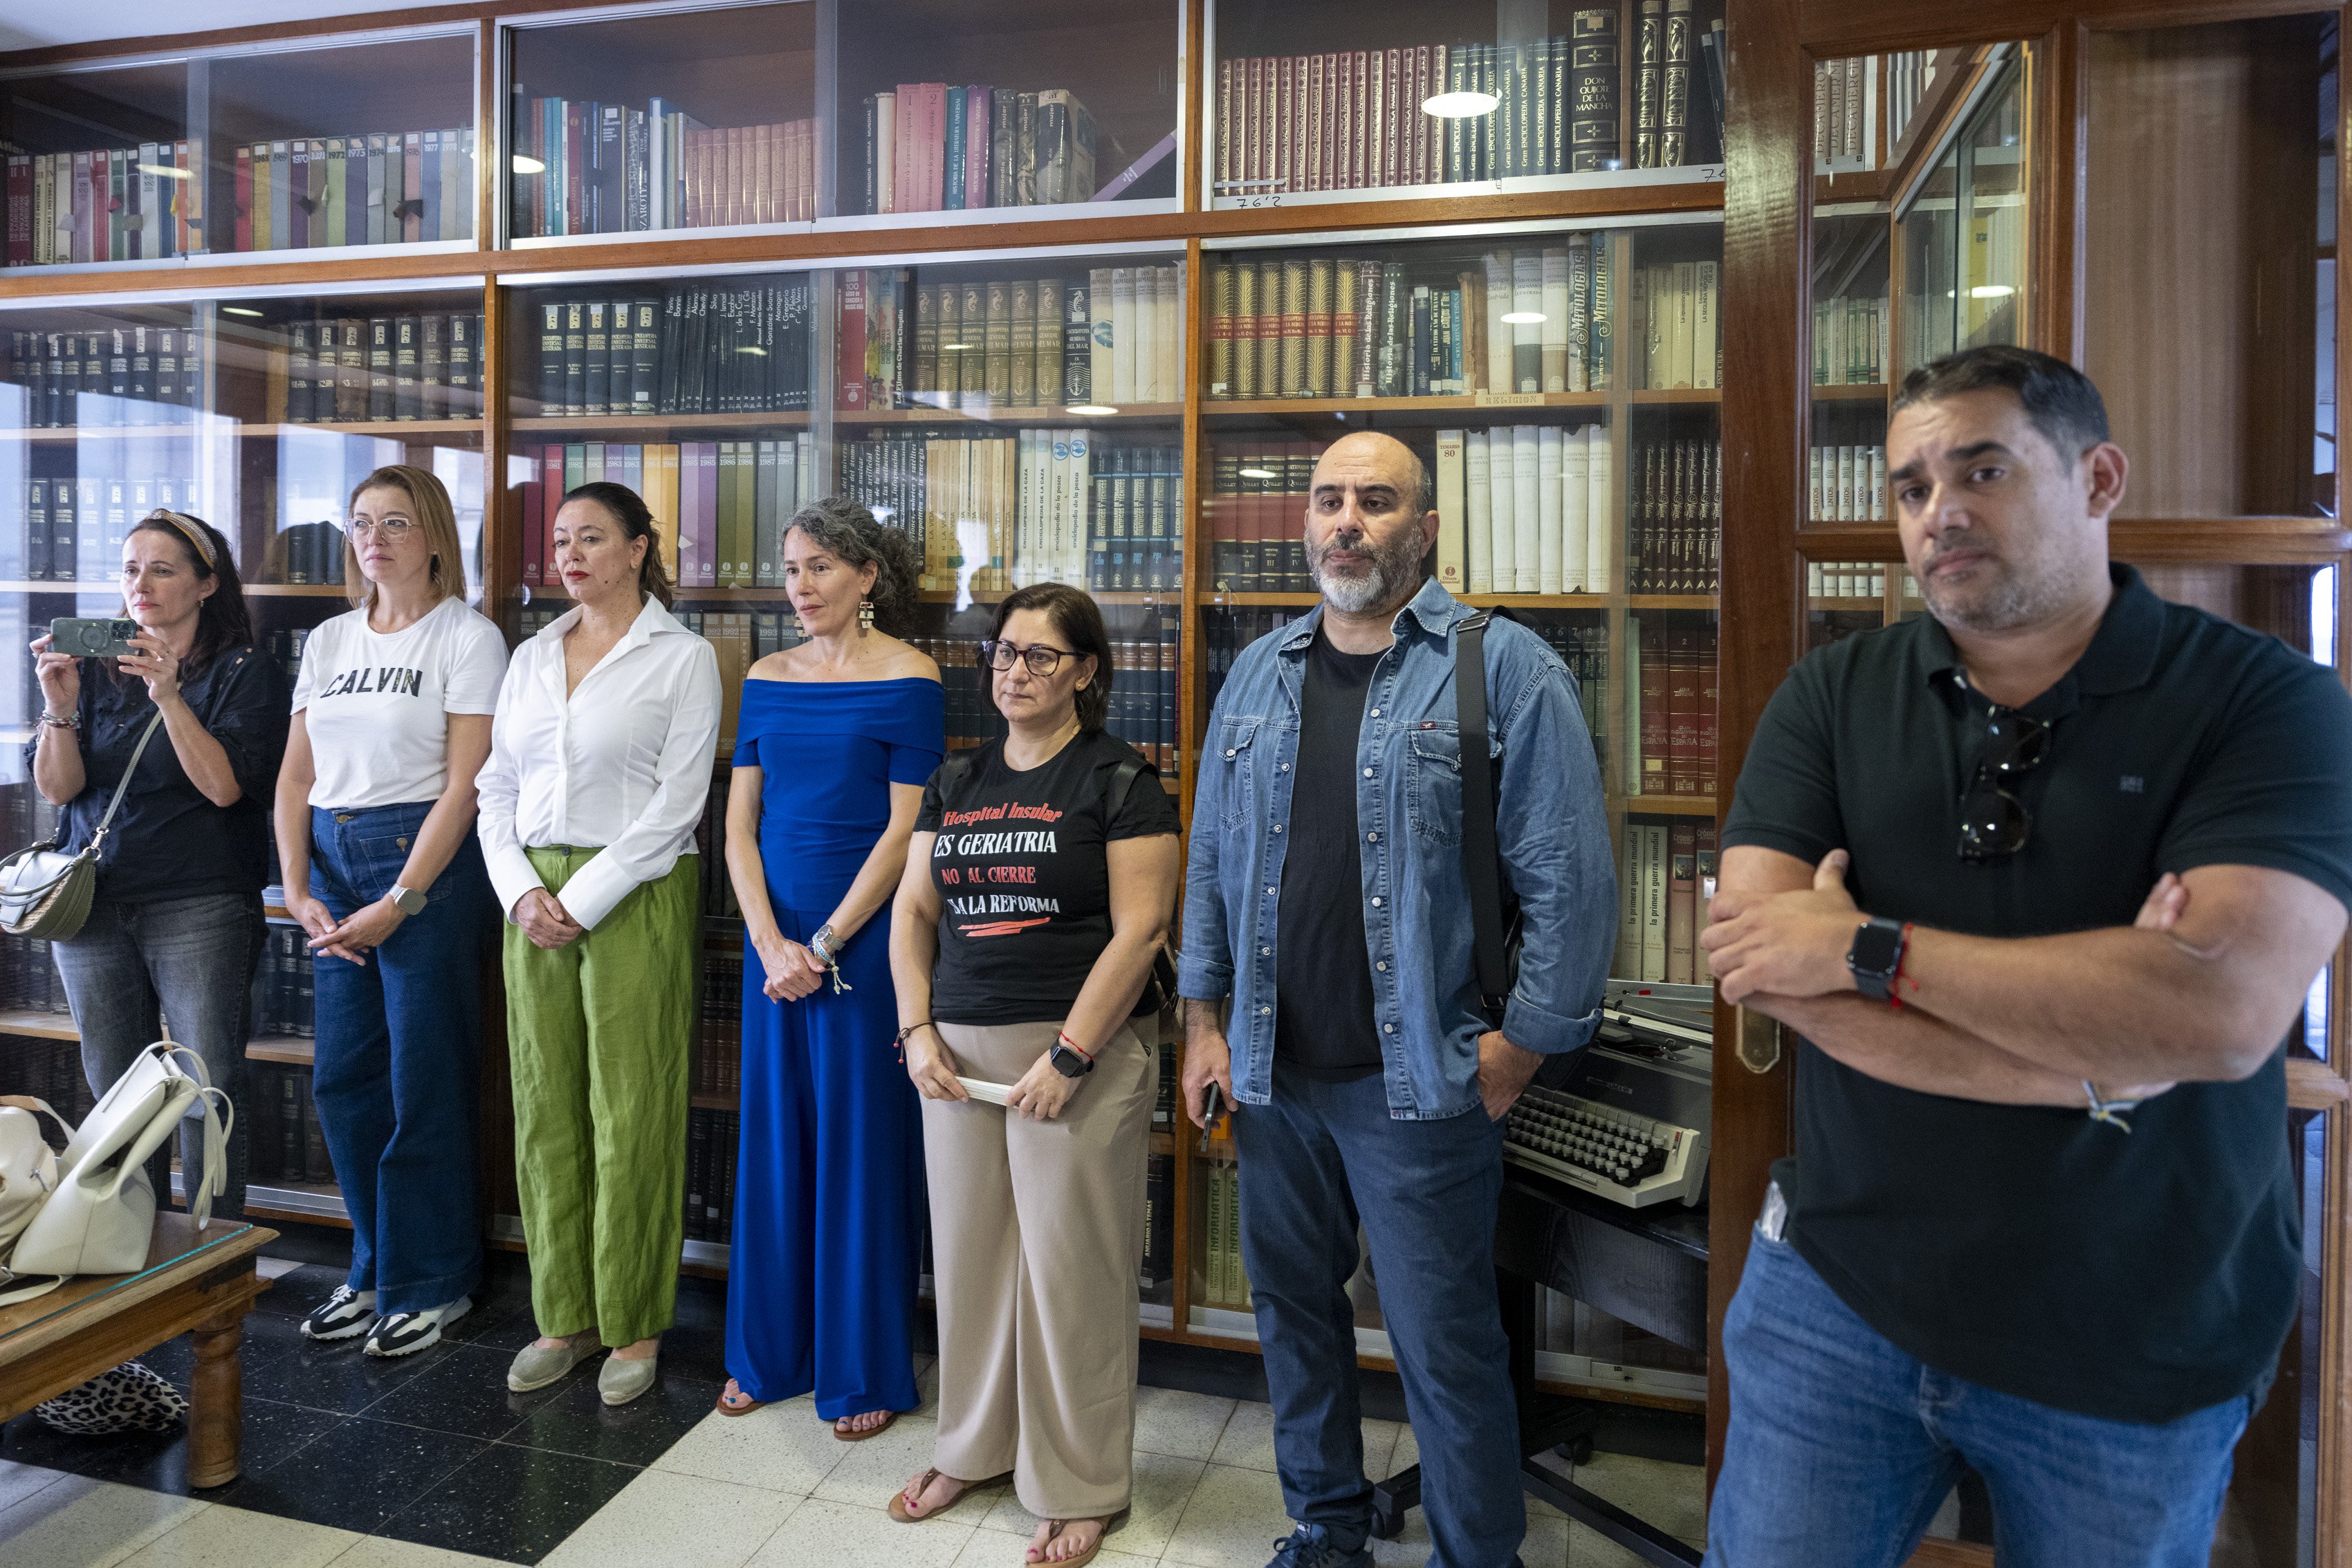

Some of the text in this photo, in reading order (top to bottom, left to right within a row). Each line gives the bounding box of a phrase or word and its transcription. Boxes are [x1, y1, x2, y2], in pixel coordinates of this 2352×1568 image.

[1584, 77, 1605, 86] DON
[1580, 86, 1610, 94] QUIJOTE
[1583, 94, 1606, 102] DE LA
[1576, 102, 1613, 111] MANCHA
[369, 148, 385, 157] 1974
[423, 144, 439, 152] 1977
[328, 151, 345, 159] 1972
[348, 148, 365, 158] 1973
[293, 155, 308, 164] 1970
[953, 162, 958, 170] DE
[867, 198, 872, 206] LA
[845, 282, 859, 290] 100
[735, 293, 743, 309] Cruz
[1366, 278, 1375, 320] Religiones
[1388, 281, 1397, 322] Religiones
[736, 318, 743, 326] de
[1444, 450, 1455, 458] 80
[919, 479, 924, 487] la
[919, 490, 923, 499] de
[1040, 486, 1044, 494] LA
[1040, 495, 1044, 504] DE
[1073, 499, 1078, 508] de
[1056, 502, 1060, 510] de
[760, 628, 778, 636] 1993
[1545, 628, 1551, 638] 5
[1558, 627, 1563, 636] 6
[1572, 627, 1578, 636] 7
[1587, 627, 1592, 636] 8
[320, 667, 423, 699] CALVIN
[1641, 736, 1667, 745] ESPAÑA
[1671, 737, 1698, 746] ESPAÑA
[943, 802, 1063, 827] Hospital Insular
[934, 831, 1057, 858] ES GERIATRIA
[1630, 831, 1638, 860] mundial
[1651, 832, 1659, 860] mundial
[941, 866, 1036, 885] NO AL CIERRE
[968, 895, 986, 914] LA
[989, 895, 1060, 914] REFORMA
[1628, 887, 1638, 916] primera
[1649, 889, 1659, 916] primera
[1211, 1179, 1220, 1252] INFORMATICA
